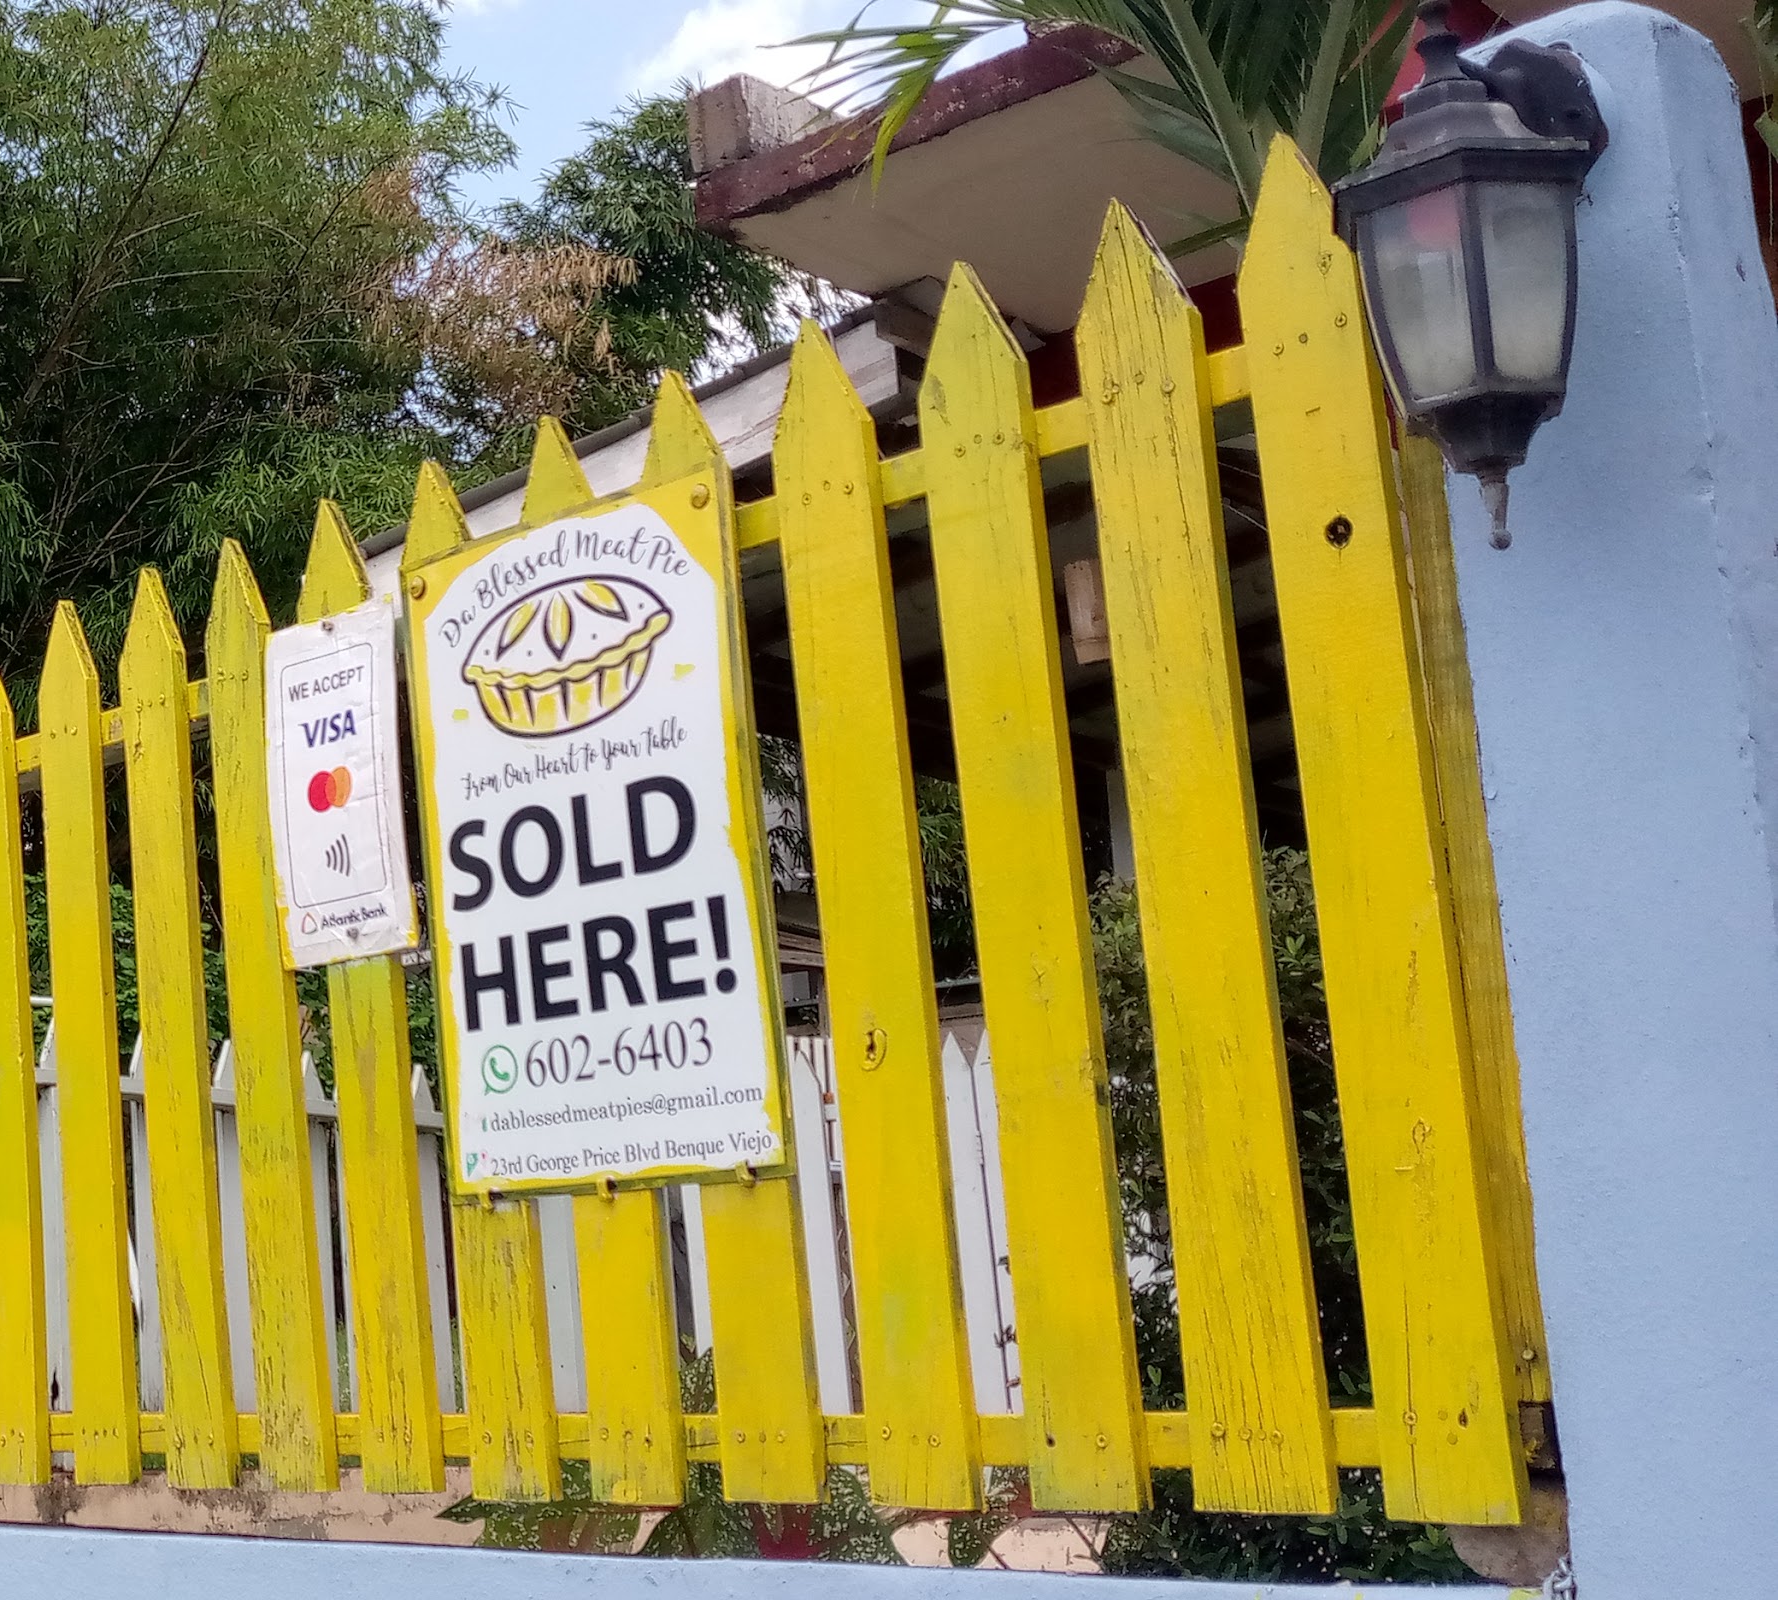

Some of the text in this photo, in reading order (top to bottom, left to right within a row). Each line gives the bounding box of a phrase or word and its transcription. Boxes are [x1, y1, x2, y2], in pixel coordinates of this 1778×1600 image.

[438, 526, 691, 648] Da Blessed Meat Pie
[288, 665, 365, 702] WE ACCEPT
[298, 708, 357, 748] VISA
[460, 772, 502, 801] From
[504, 762, 533, 789] Our
[534, 742, 579, 780] Heart
[600, 737, 641, 771] Your
[448, 774, 698, 912] SOLD
[321, 902, 389, 930] Atlantic Bank
[460, 894, 739, 1034] HERE!
[525, 1016, 714, 1088] 602-6403
[490, 1085, 763, 1132] dablessedmeatpies@gmail.com
[491, 1130, 772, 1176] 23rd George Price Blvd Benque Viejo
